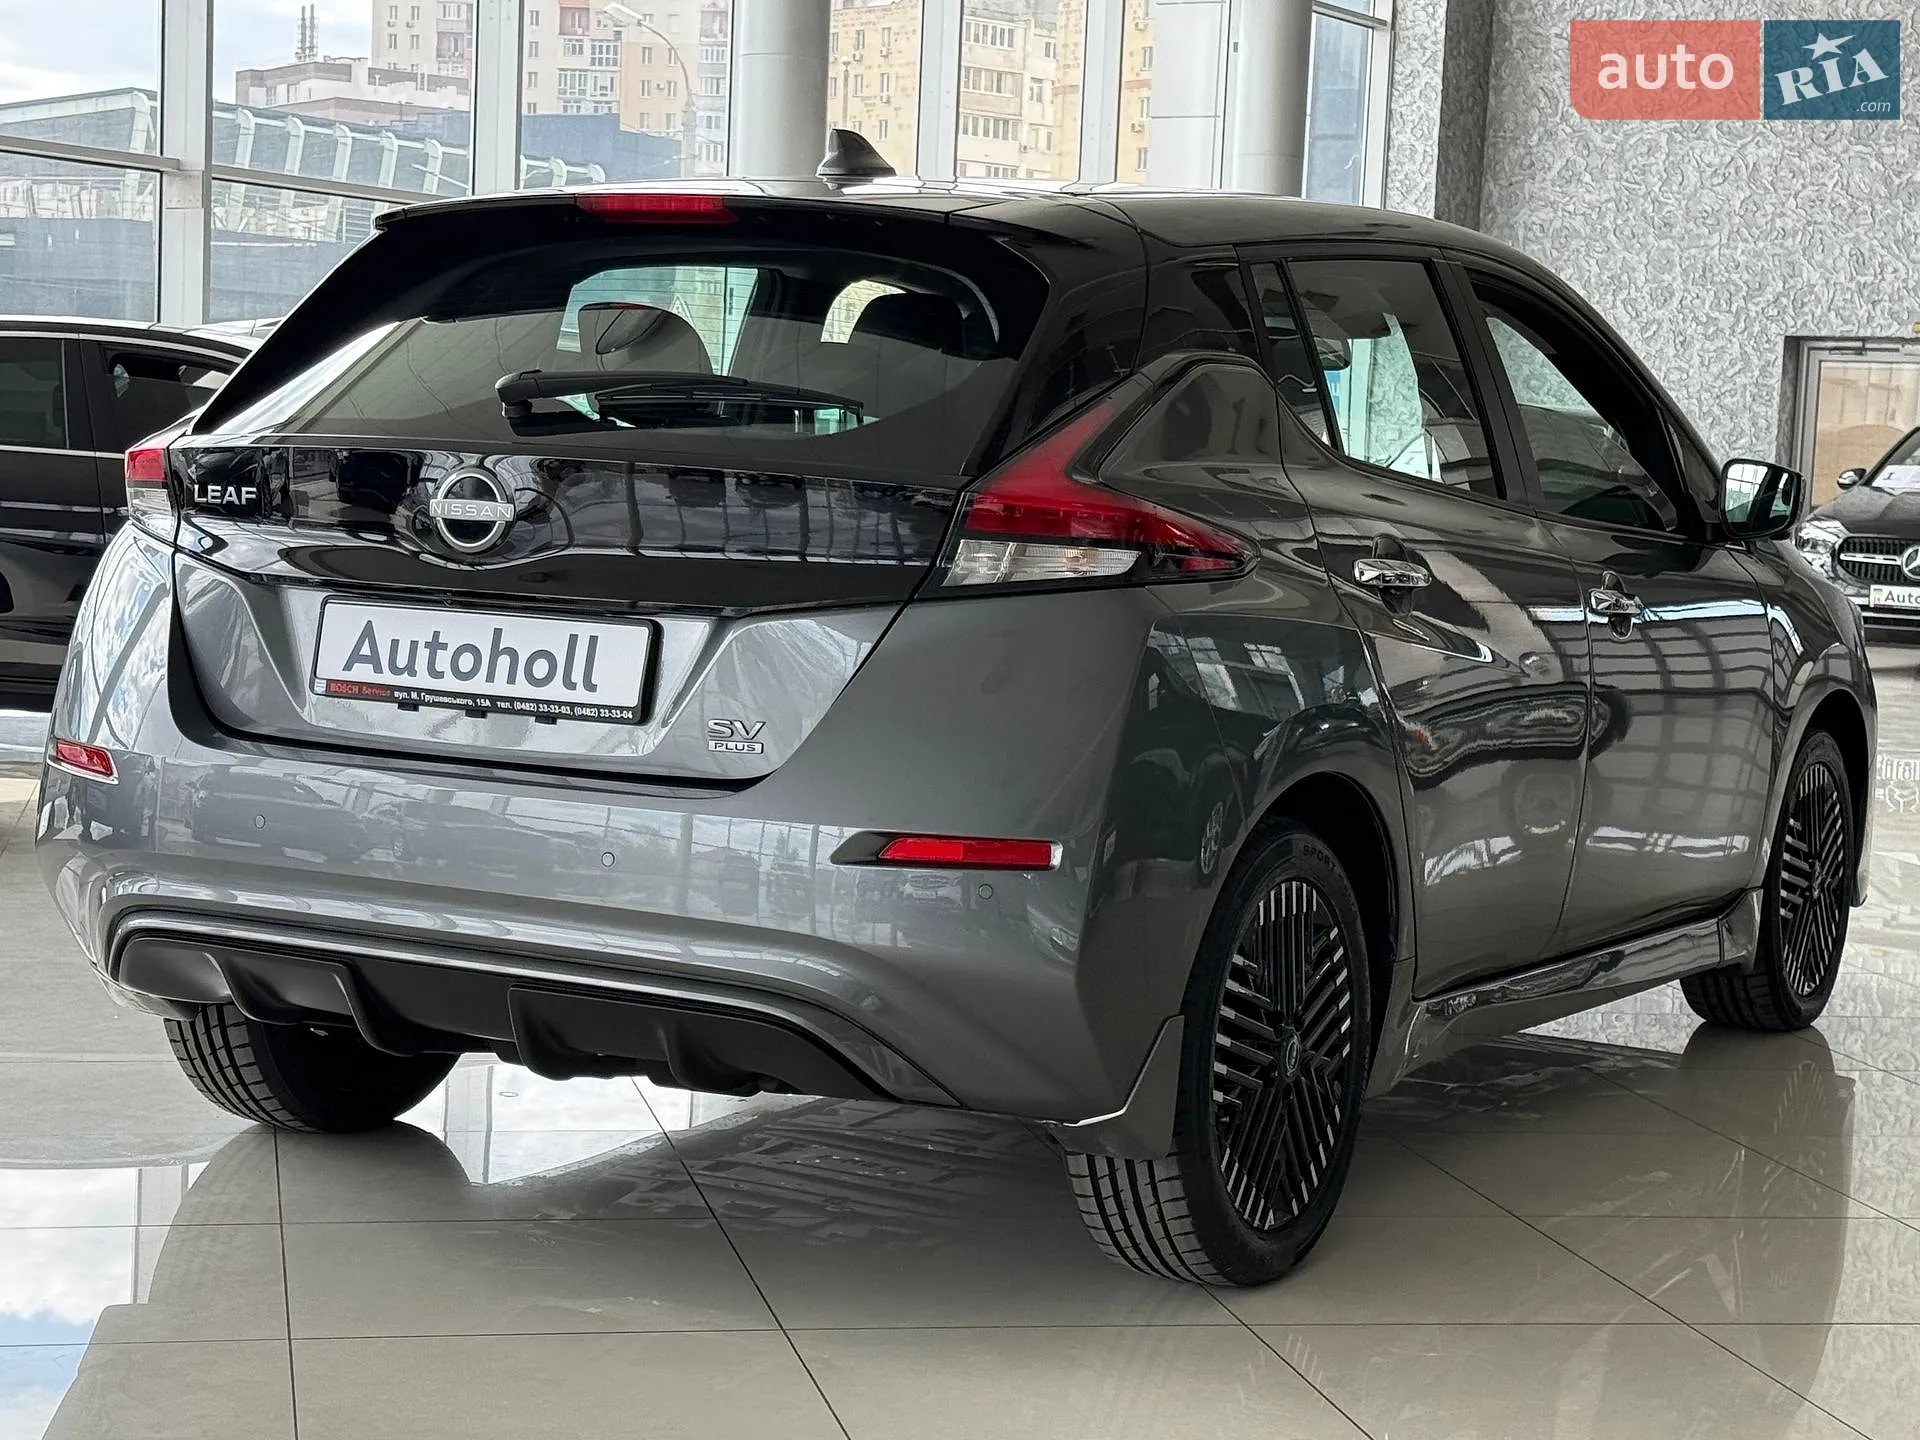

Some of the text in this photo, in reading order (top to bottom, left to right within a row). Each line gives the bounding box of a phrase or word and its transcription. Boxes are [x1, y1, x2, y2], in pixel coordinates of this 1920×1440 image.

[194, 484, 257, 505] LEAF
[431, 502, 511, 518] NISSAN
[343, 620, 599, 693] Autoholl
[330, 683, 359, 695] BOSCH
[362, 685, 391, 697] Service
[514, 701, 538, 712] (0482)
[538, 704, 574, 716] 33-33-03,
[574, 706, 599, 718] (0482)
[599, 709, 633, 720] 33-33-04
[707, 718, 767, 740] SV
[714, 742, 756, 752] PLUS
